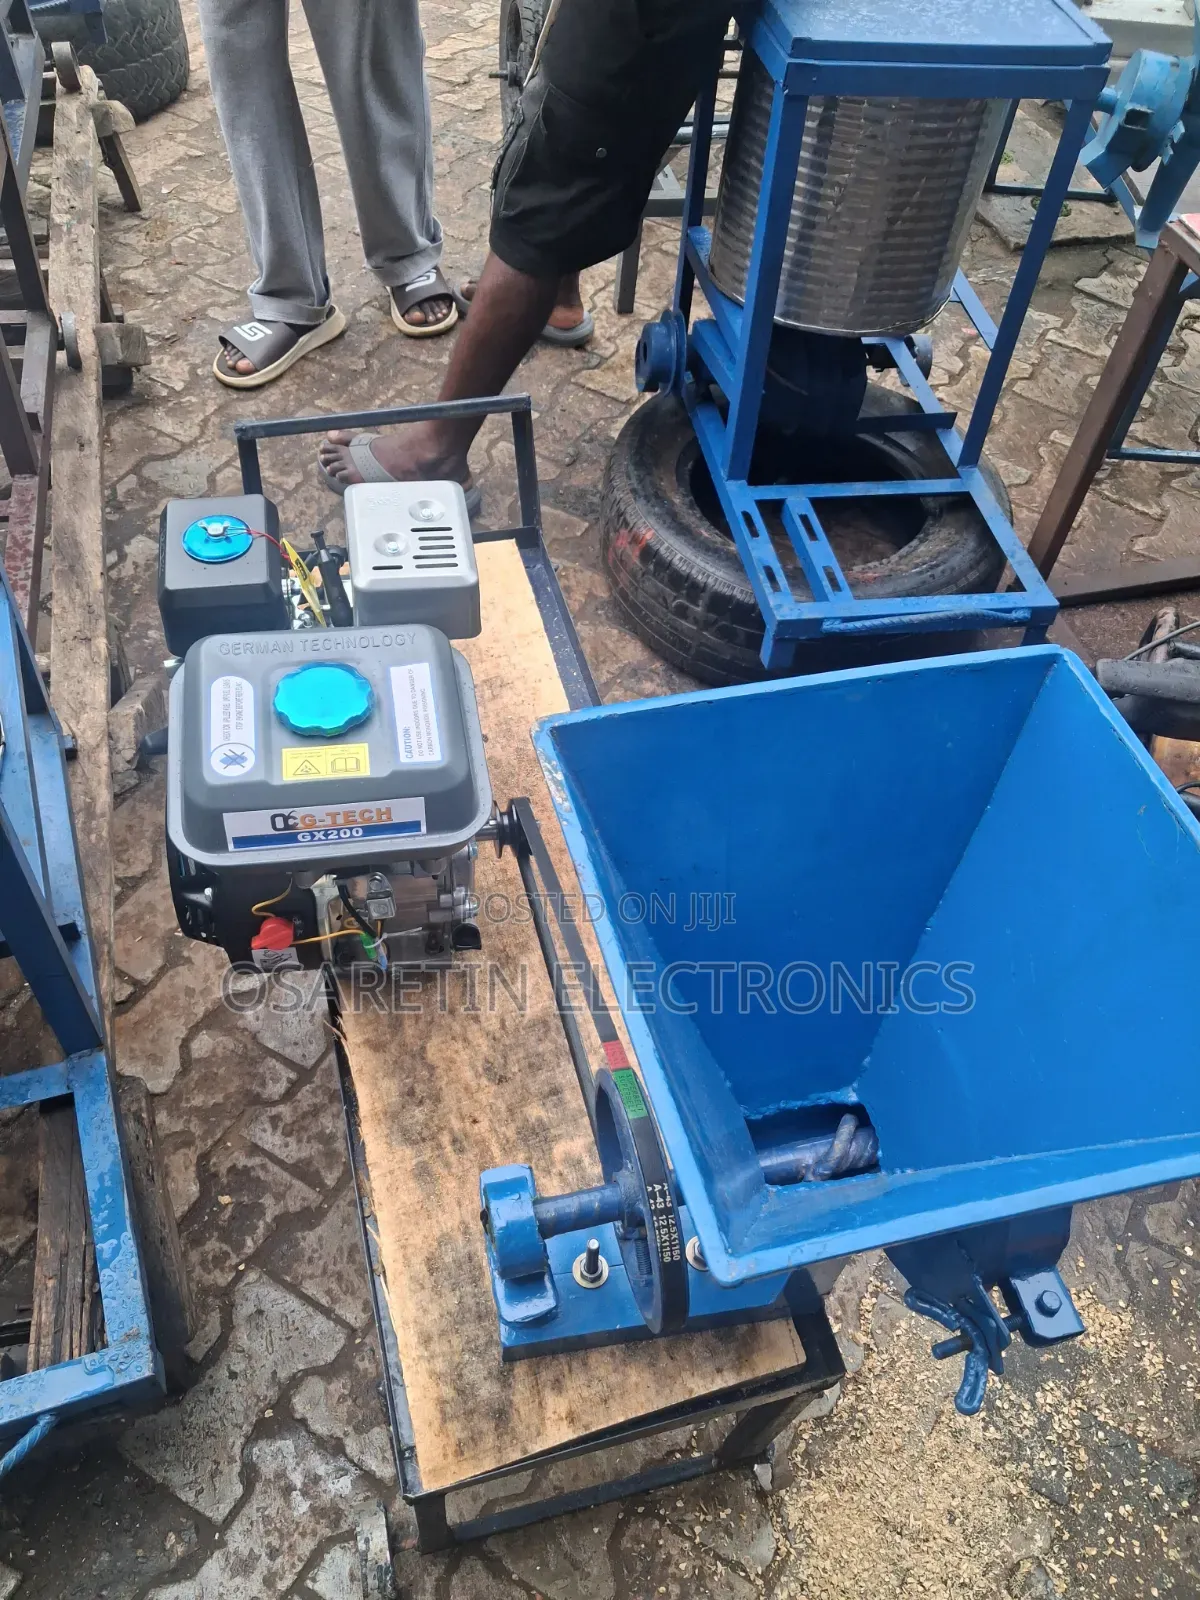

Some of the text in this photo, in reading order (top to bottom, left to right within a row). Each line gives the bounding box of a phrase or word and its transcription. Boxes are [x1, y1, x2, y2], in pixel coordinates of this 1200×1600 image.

[218, 633, 417, 657] GERMAN TECHNOLOGY
[402, 726, 414, 759] CAUTION:
[297, 827, 364, 842] GX200
[653, 1183, 665, 1209] A-43
[658, 1214, 672, 1263] 12.5X1150
